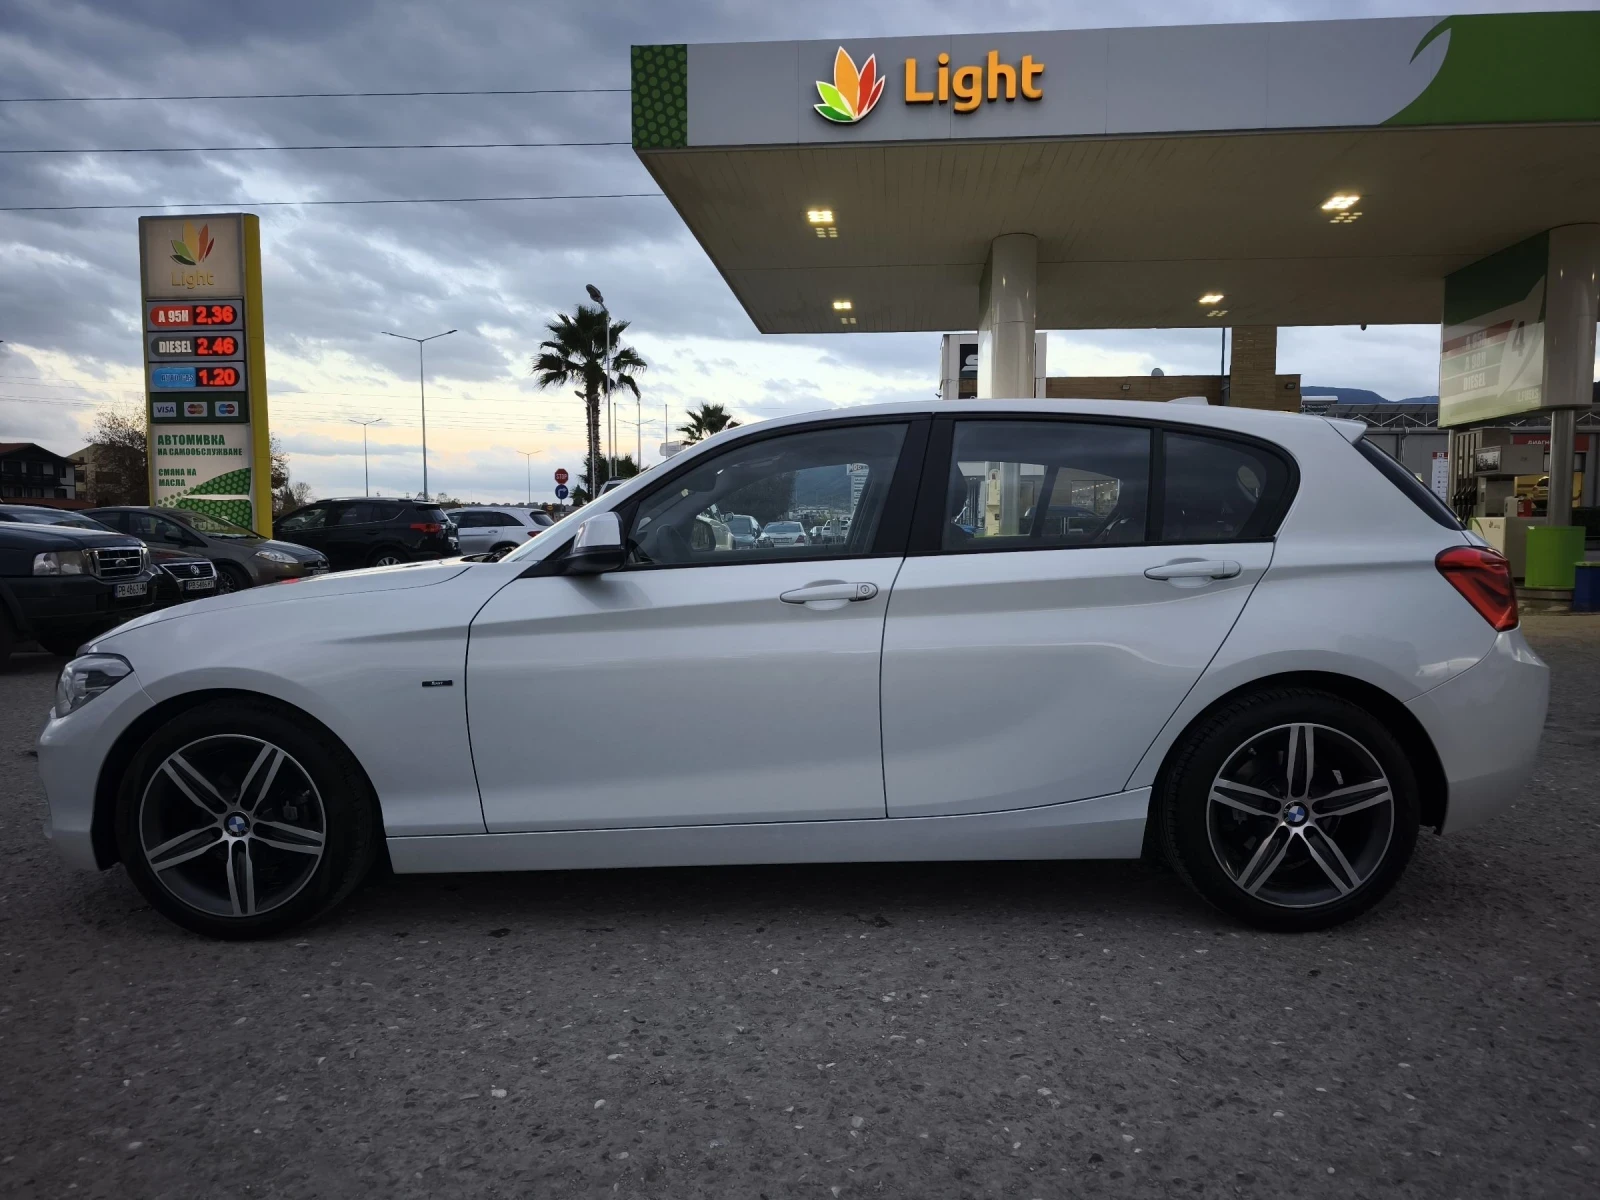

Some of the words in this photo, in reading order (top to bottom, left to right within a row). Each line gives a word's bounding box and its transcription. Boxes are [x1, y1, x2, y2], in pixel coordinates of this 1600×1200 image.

[905, 50, 1045, 113] Light
[171, 270, 215, 289] Light
[159, 340, 192, 353] DIESEL
[196, 337, 235, 354] 2.46
[1511, 321, 1526, 357] 4
[198, 367, 236, 385] 1.20
[1463, 372, 1486, 391] DIESEL
[157, 435, 225, 446] АВТОМИВКА
[157, 448, 168, 456] НА
[169, 448, 243, 456] САМООБСЛУЖВАНЕ
[158, 468, 185, 477] СМЯНА
[186, 468, 197, 477] НА
[556, 473, 567, 481] STOP
[158, 479, 186, 487] МАСЛА
